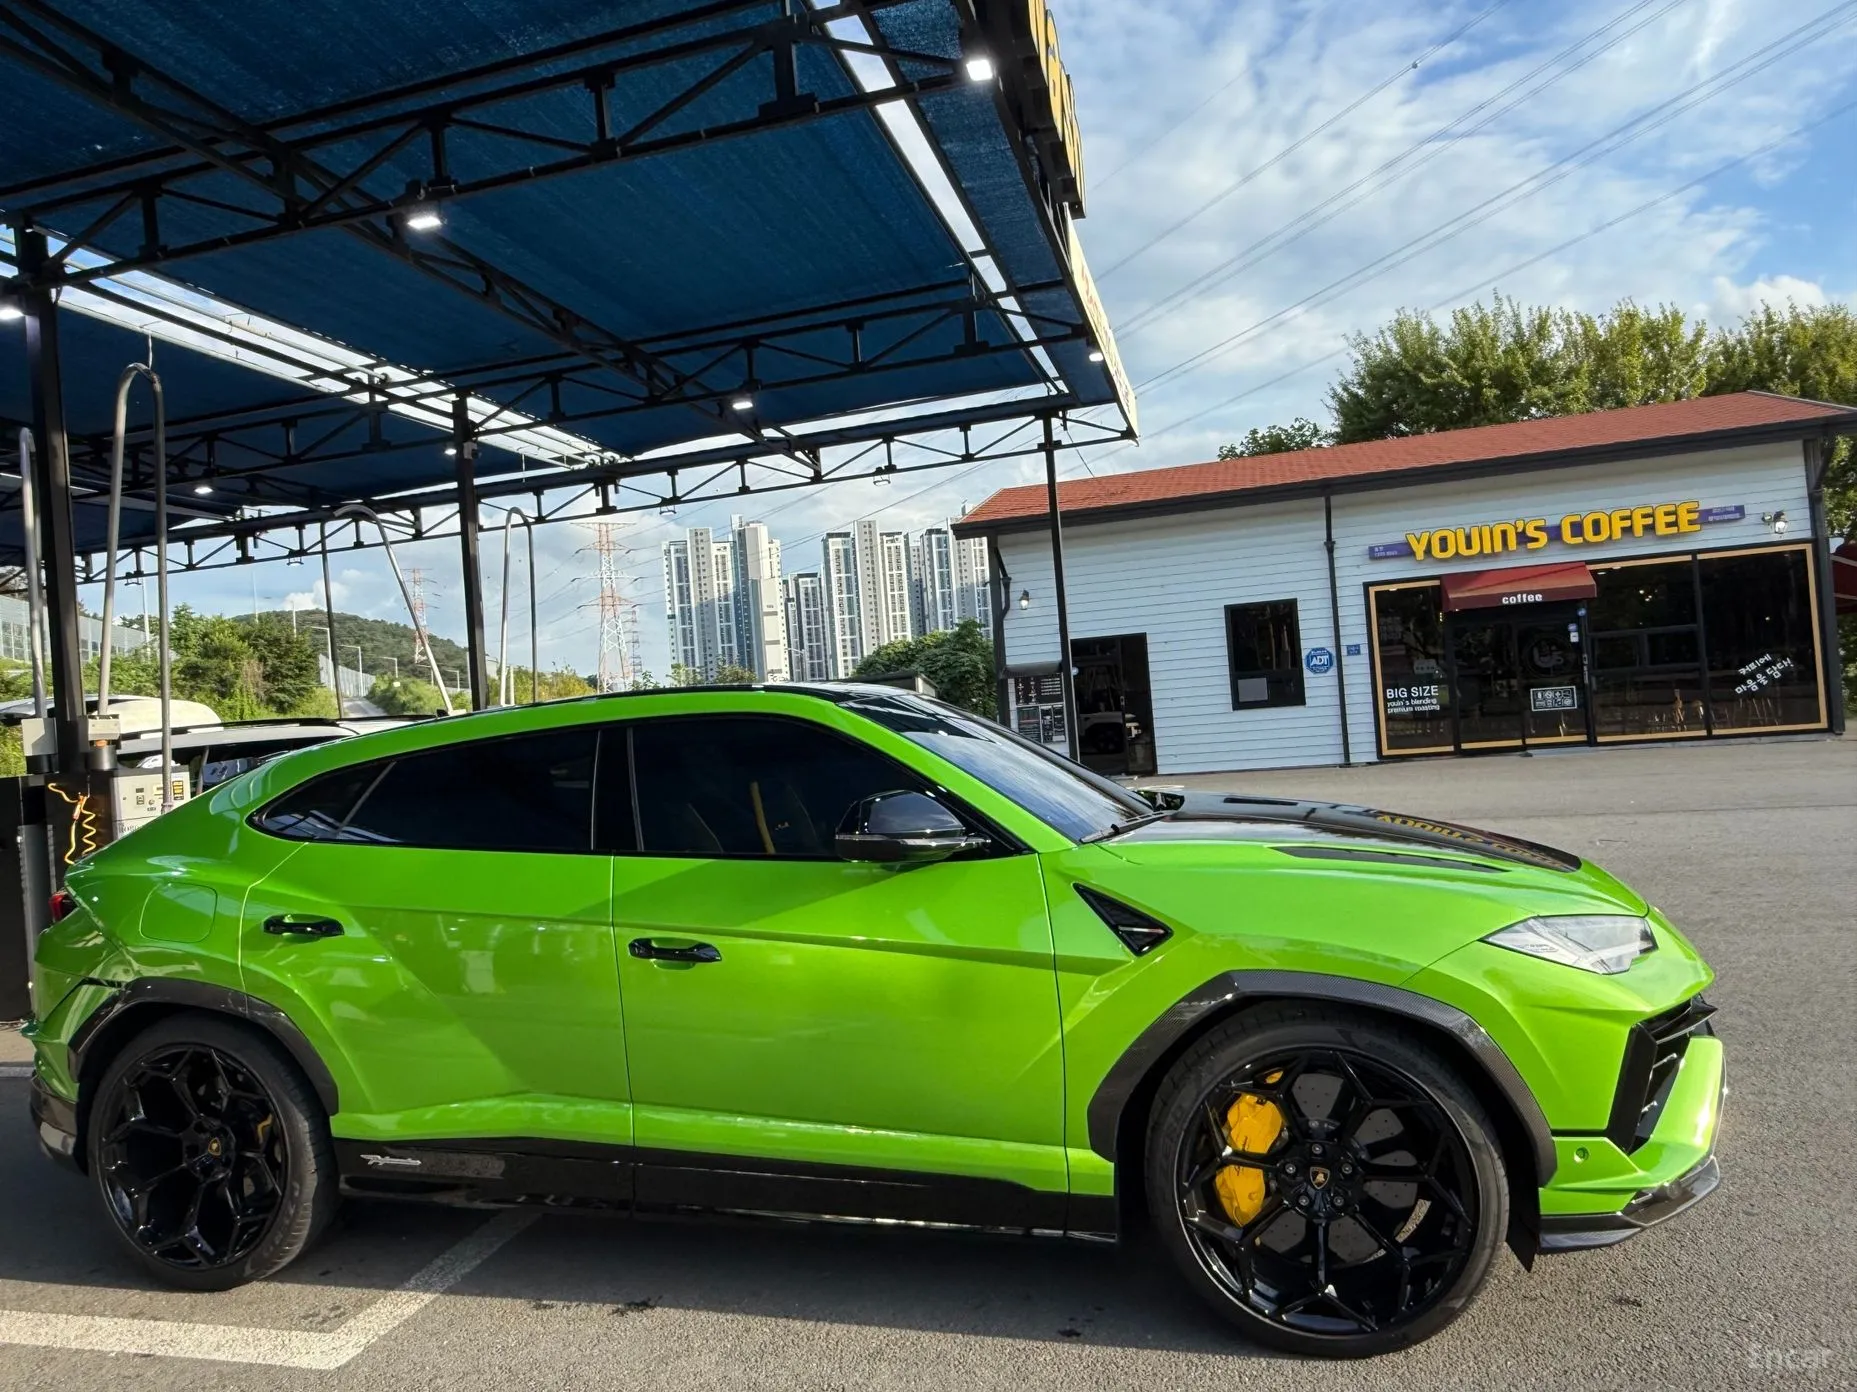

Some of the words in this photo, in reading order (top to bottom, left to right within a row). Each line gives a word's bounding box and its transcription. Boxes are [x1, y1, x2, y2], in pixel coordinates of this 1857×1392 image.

[1405, 518, 1548, 561] YOUIN'S
[1560, 501, 1701, 545] COFFEE
[1502, 593, 1543, 605] coffee
[1310, 655, 1329, 667] ADT
[1735, 673, 1768, 694] 마음을
[1766, 657, 1794, 679] 담다!
[1386, 687, 1407, 699] BIG
[1411, 685, 1439, 697] SIZE
